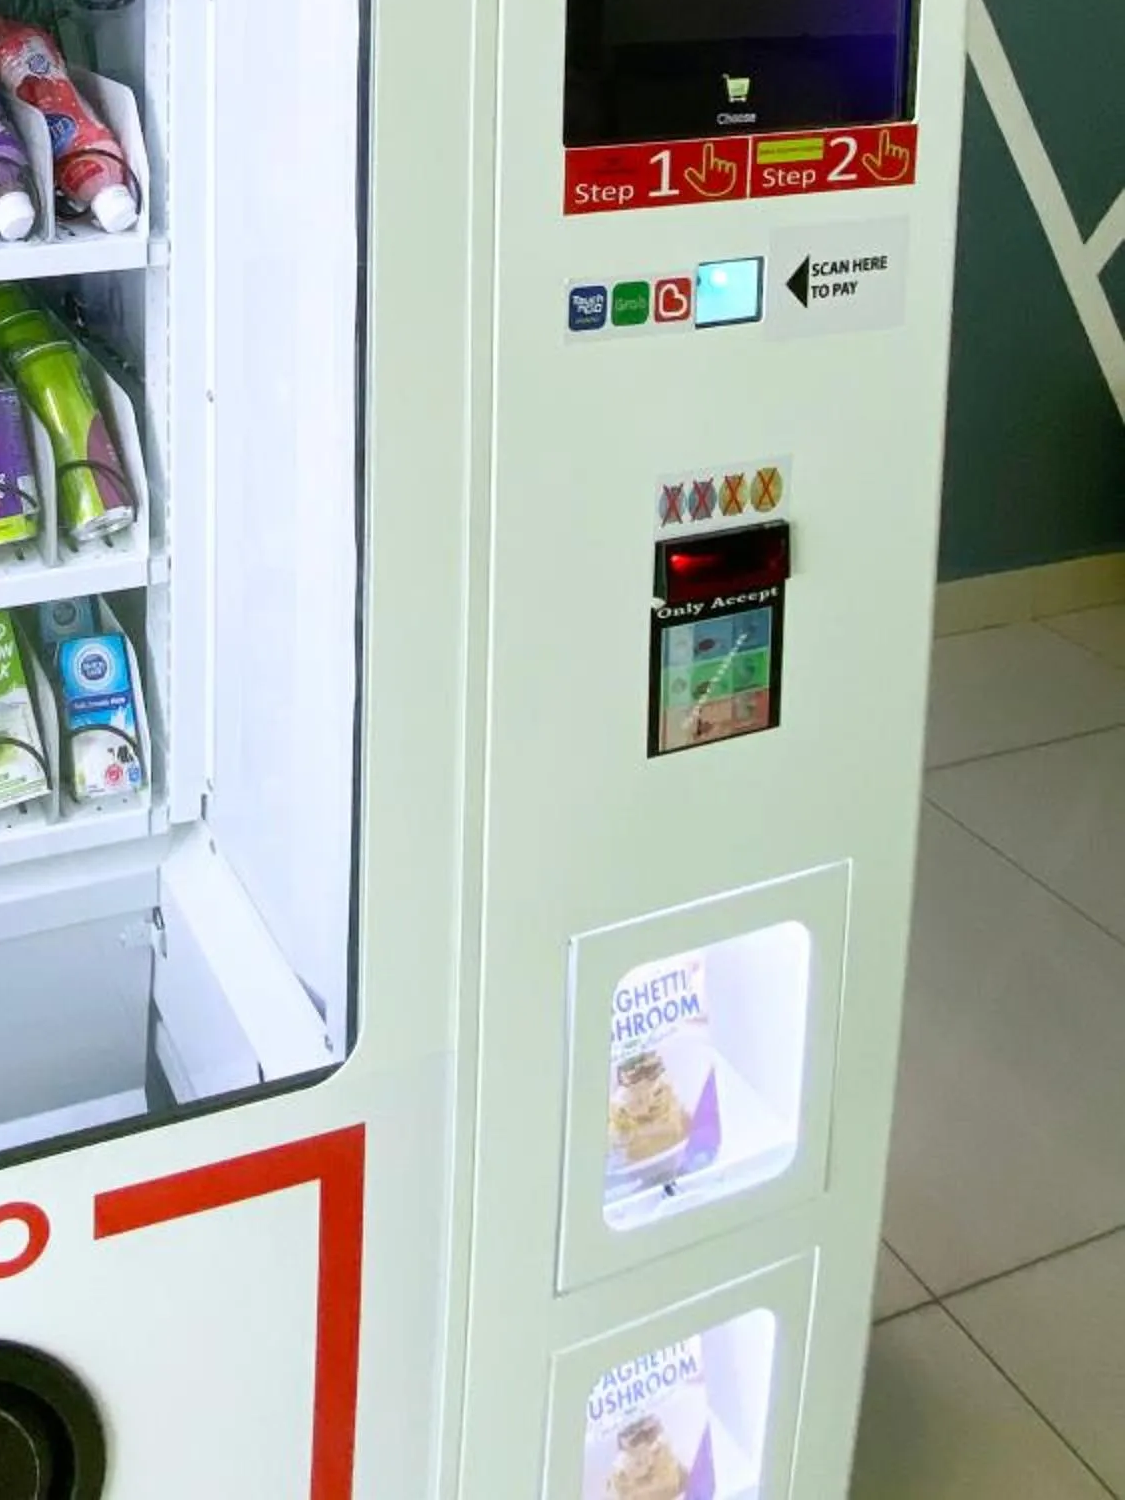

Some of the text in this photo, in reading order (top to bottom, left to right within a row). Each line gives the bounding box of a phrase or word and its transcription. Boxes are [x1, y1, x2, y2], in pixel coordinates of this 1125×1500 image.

[574, 150, 680, 205] Step 1
[761, 135, 858, 191] Step 2
[811, 255, 889, 278] SCAN HERE
[811, 280, 859, 300] TO PAY
[656, 585, 780, 621] Only Accept
[616, 968, 687, 1013] GHETTI
[615, 993, 701, 1042] HROOM
